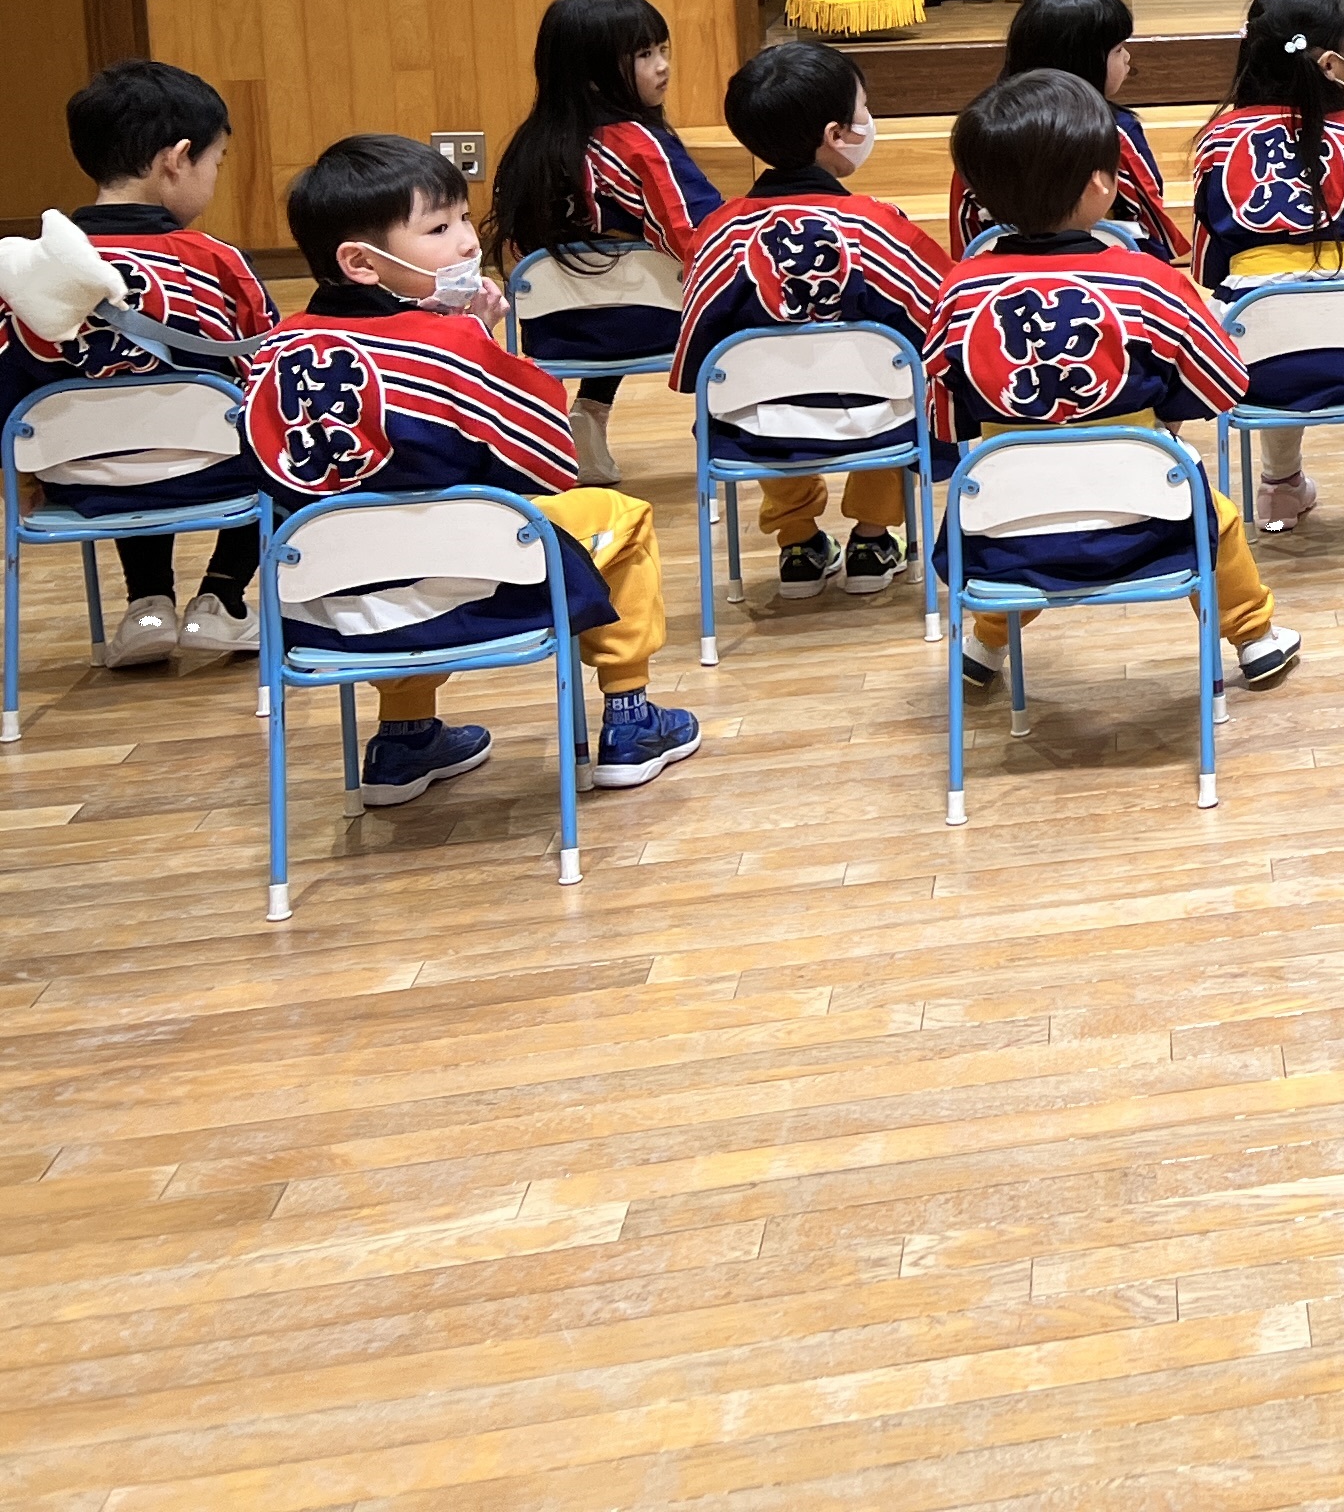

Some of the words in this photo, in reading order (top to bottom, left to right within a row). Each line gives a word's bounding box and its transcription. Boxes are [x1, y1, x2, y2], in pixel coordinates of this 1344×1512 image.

[757, 215, 843, 323] 防火
[275, 344, 375, 486] 防火
[989, 286, 1109, 421] 防火
